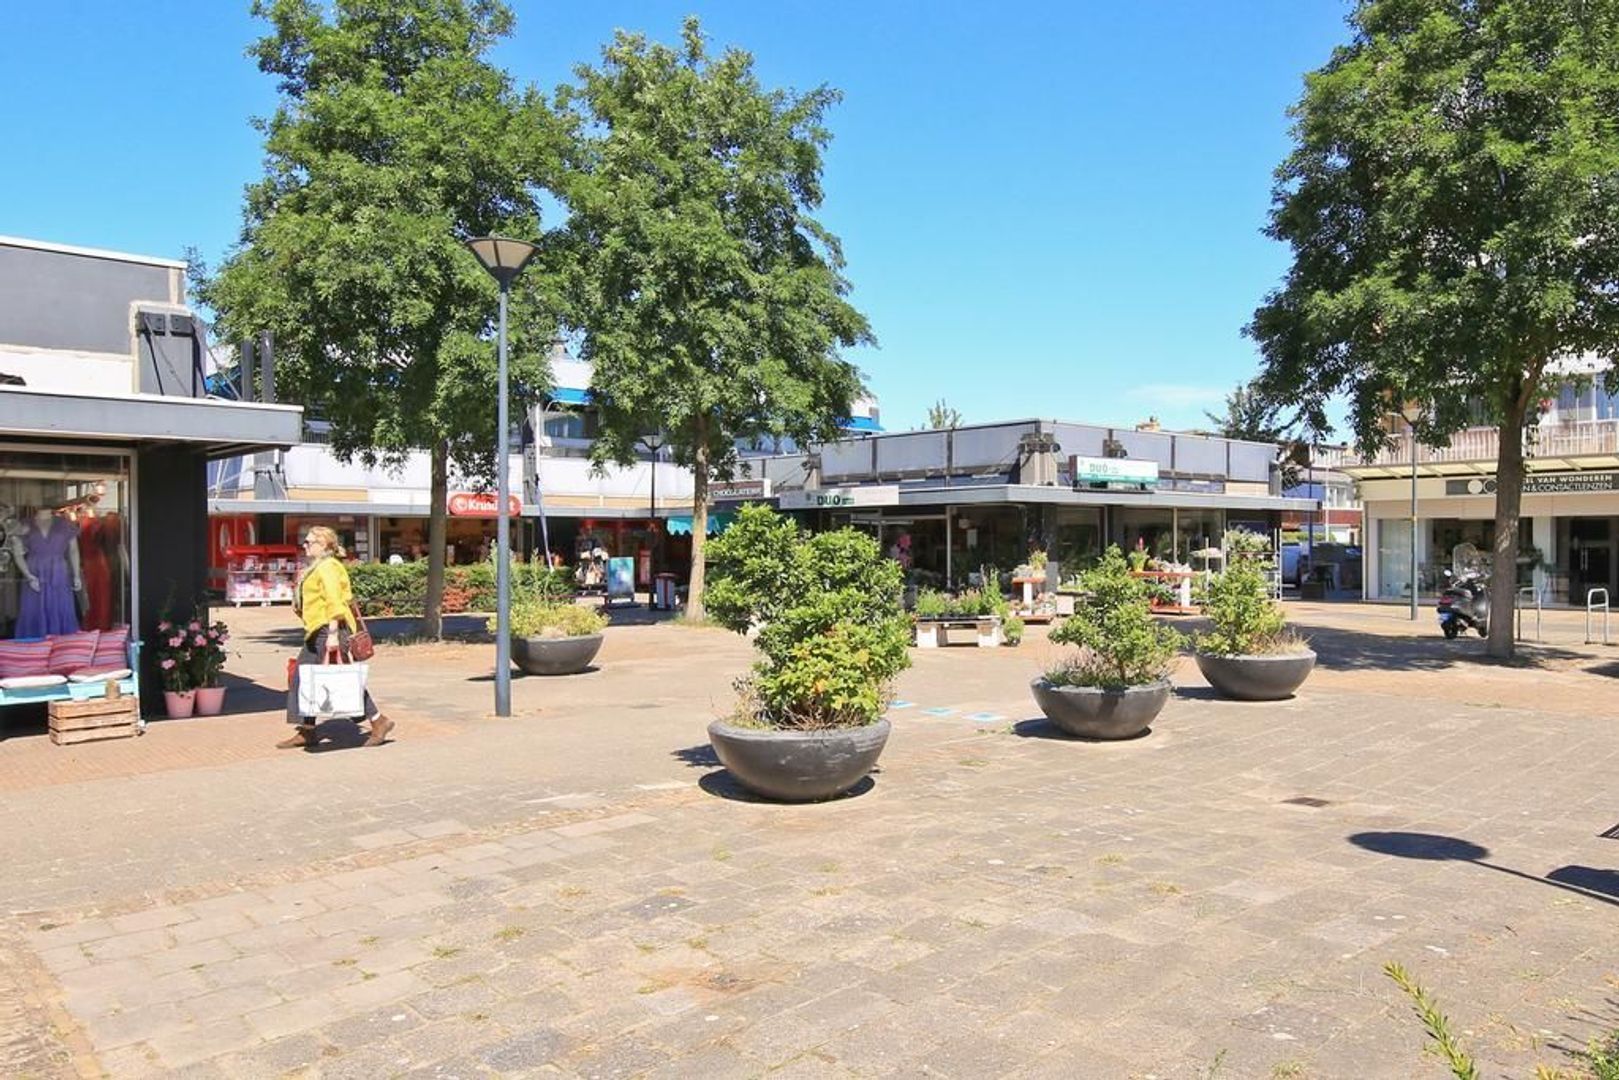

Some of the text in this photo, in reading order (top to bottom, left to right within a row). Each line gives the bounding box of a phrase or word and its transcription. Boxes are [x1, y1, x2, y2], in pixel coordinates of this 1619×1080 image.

[1089, 463, 1108, 473] DUO
[1559, 475, 1613, 483] WONDEREN
[817, 494, 841, 506] DUO
